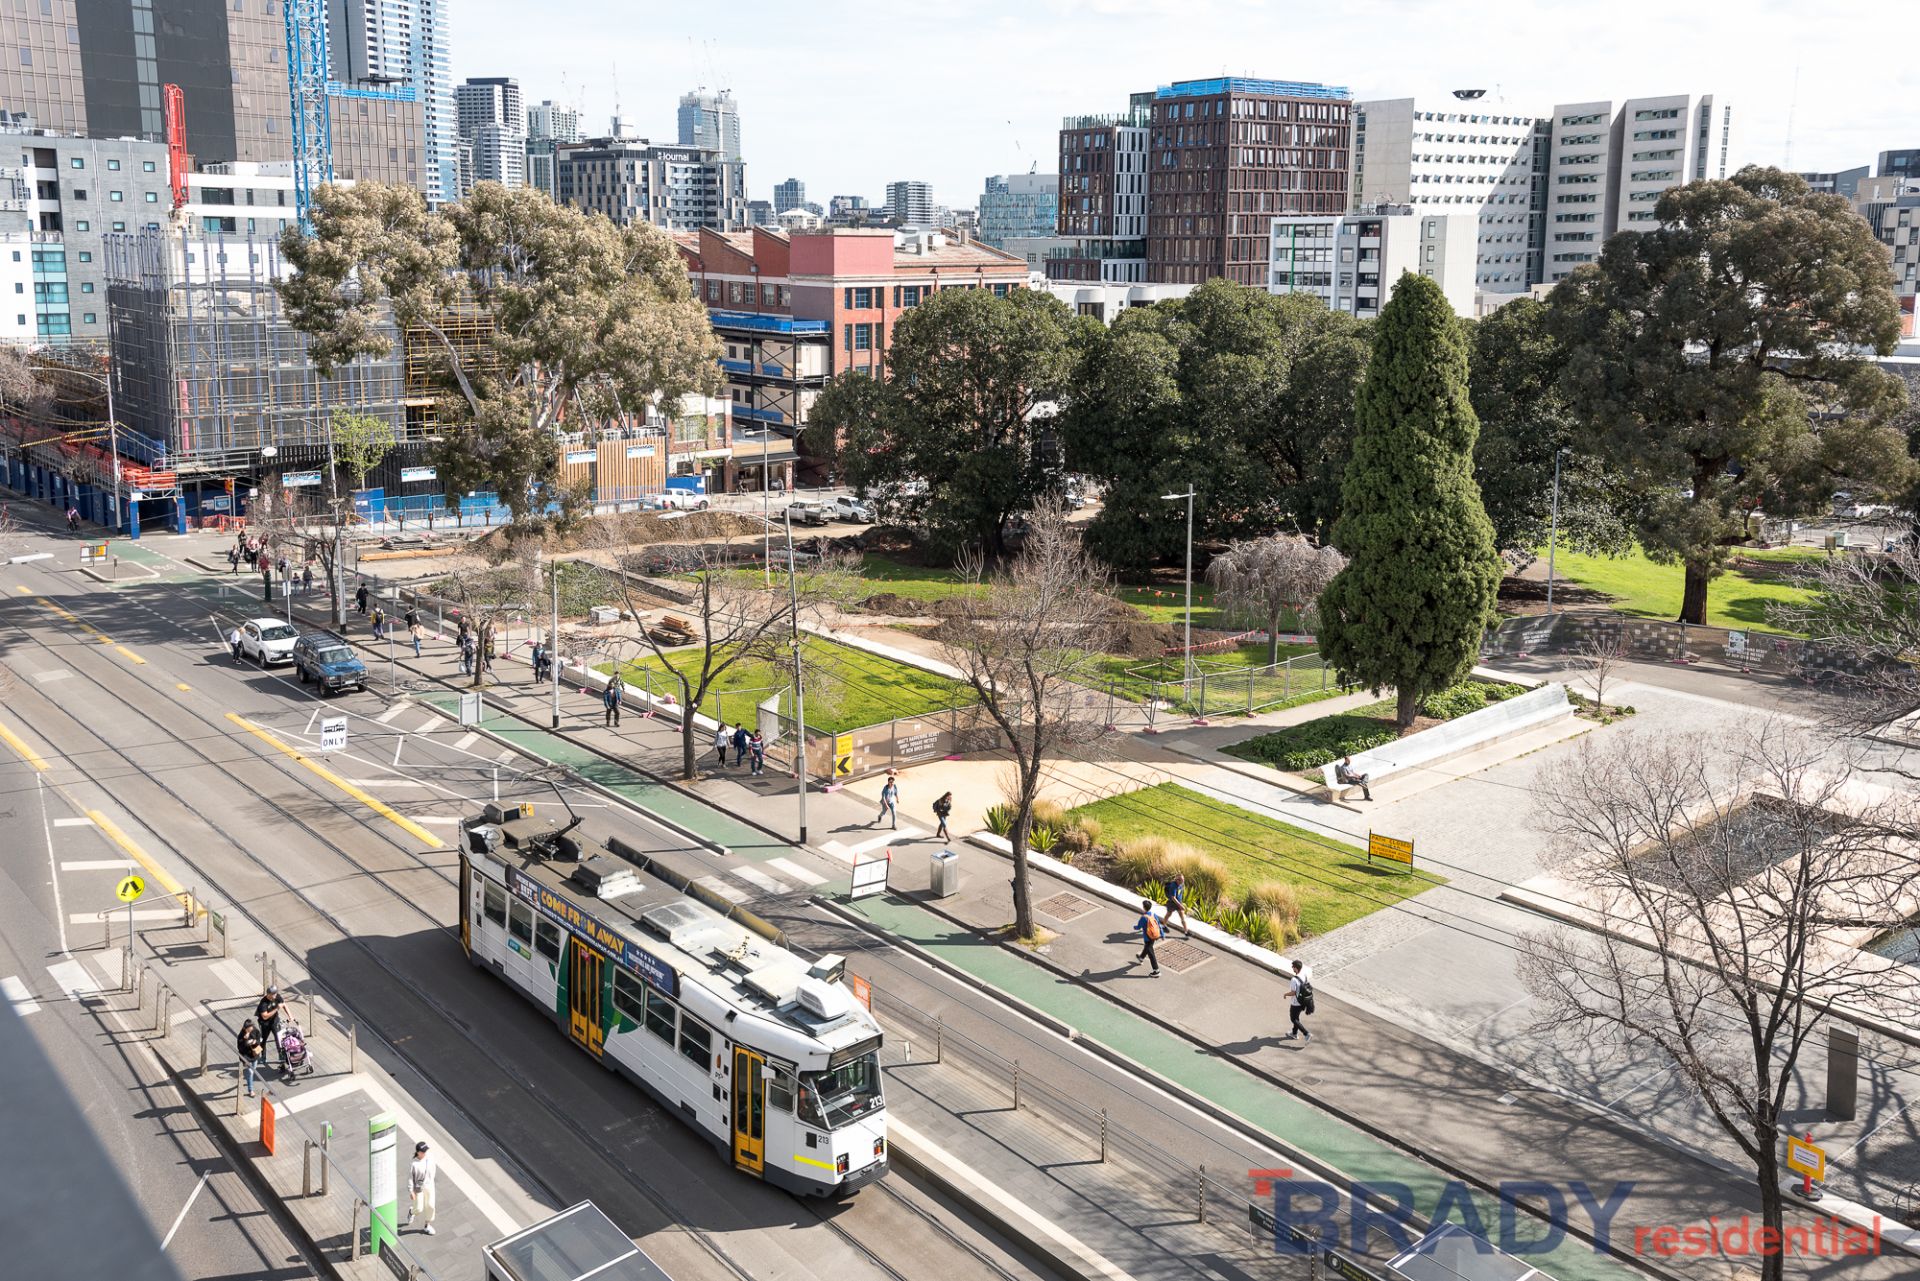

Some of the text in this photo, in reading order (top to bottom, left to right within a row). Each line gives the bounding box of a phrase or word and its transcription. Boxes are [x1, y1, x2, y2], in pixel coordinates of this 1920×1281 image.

[323, 738, 344, 746] ONLY
[541, 890, 567, 918] COME
[567, 907, 596, 937] FROM
[596, 928, 625, 954] AWAY
[869, 1095, 883, 1109] 213
[817, 1135, 829, 1144] 213
